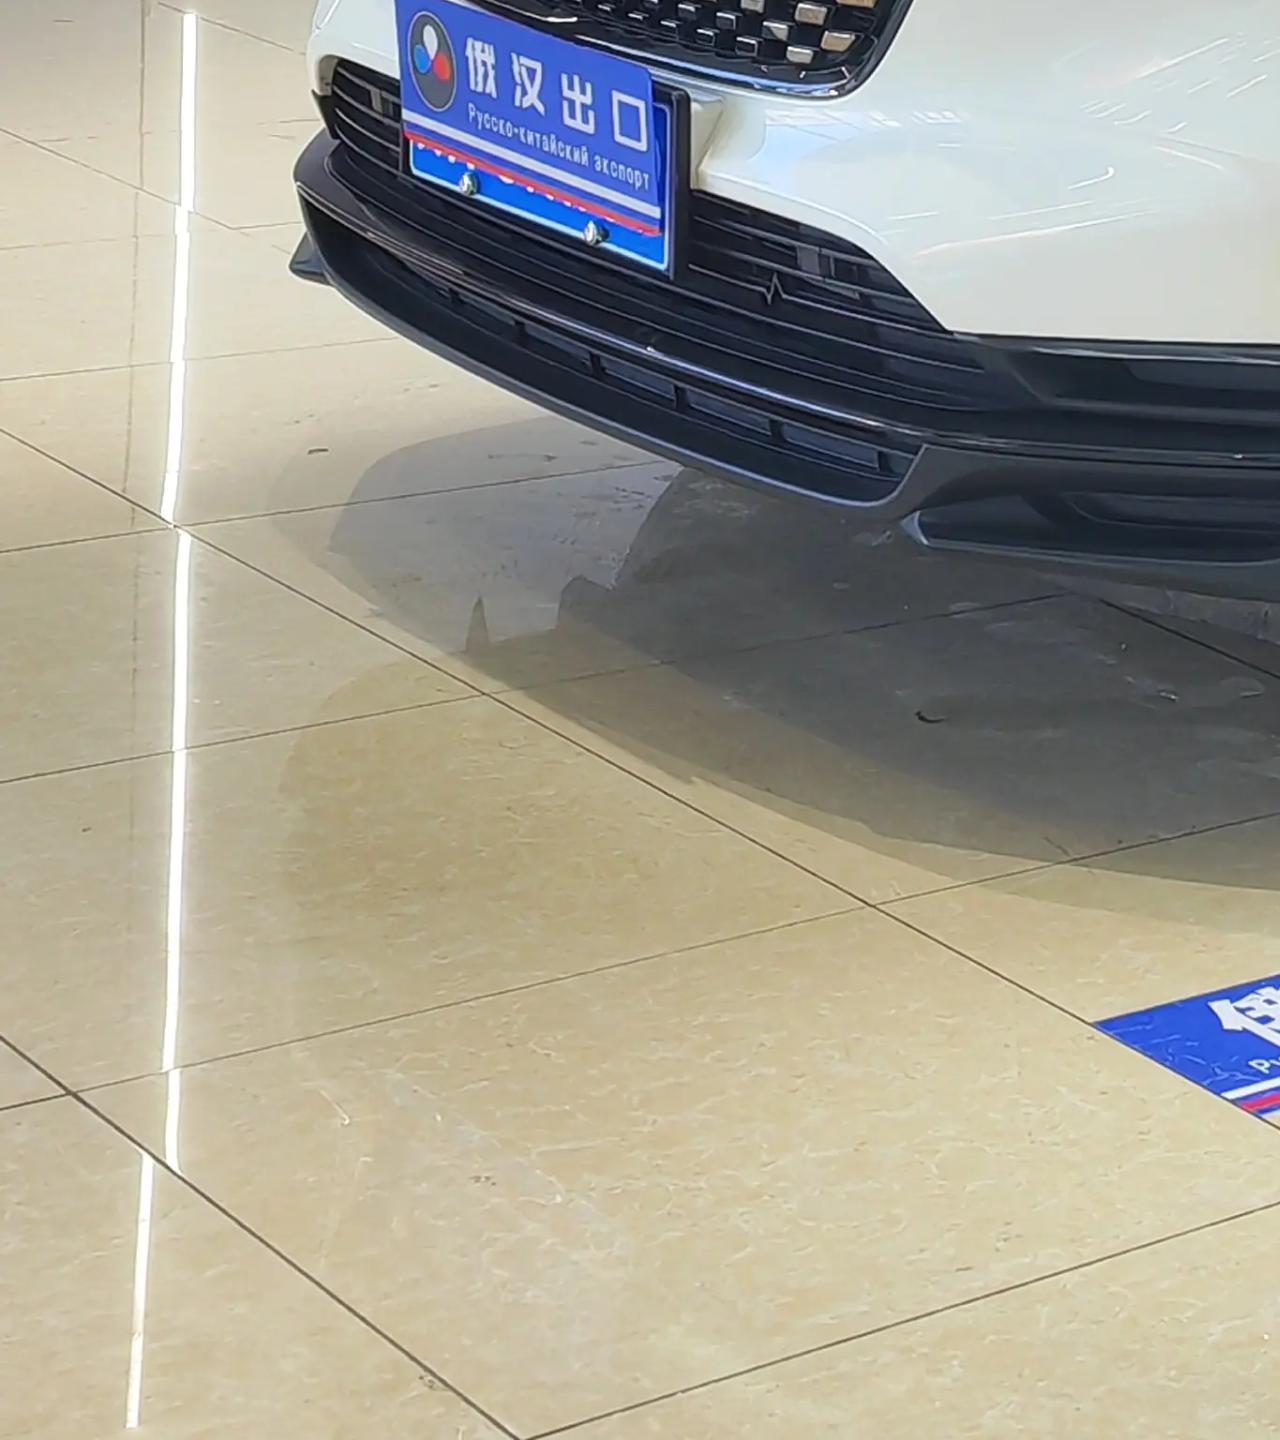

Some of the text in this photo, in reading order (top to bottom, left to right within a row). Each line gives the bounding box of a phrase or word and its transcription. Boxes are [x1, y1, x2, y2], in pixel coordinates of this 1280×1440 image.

[465, 36, 649, 153] 俄汉出口
[467, 101, 590, 168] Русско-китайский
[593, 152, 651, 192] экспорт
